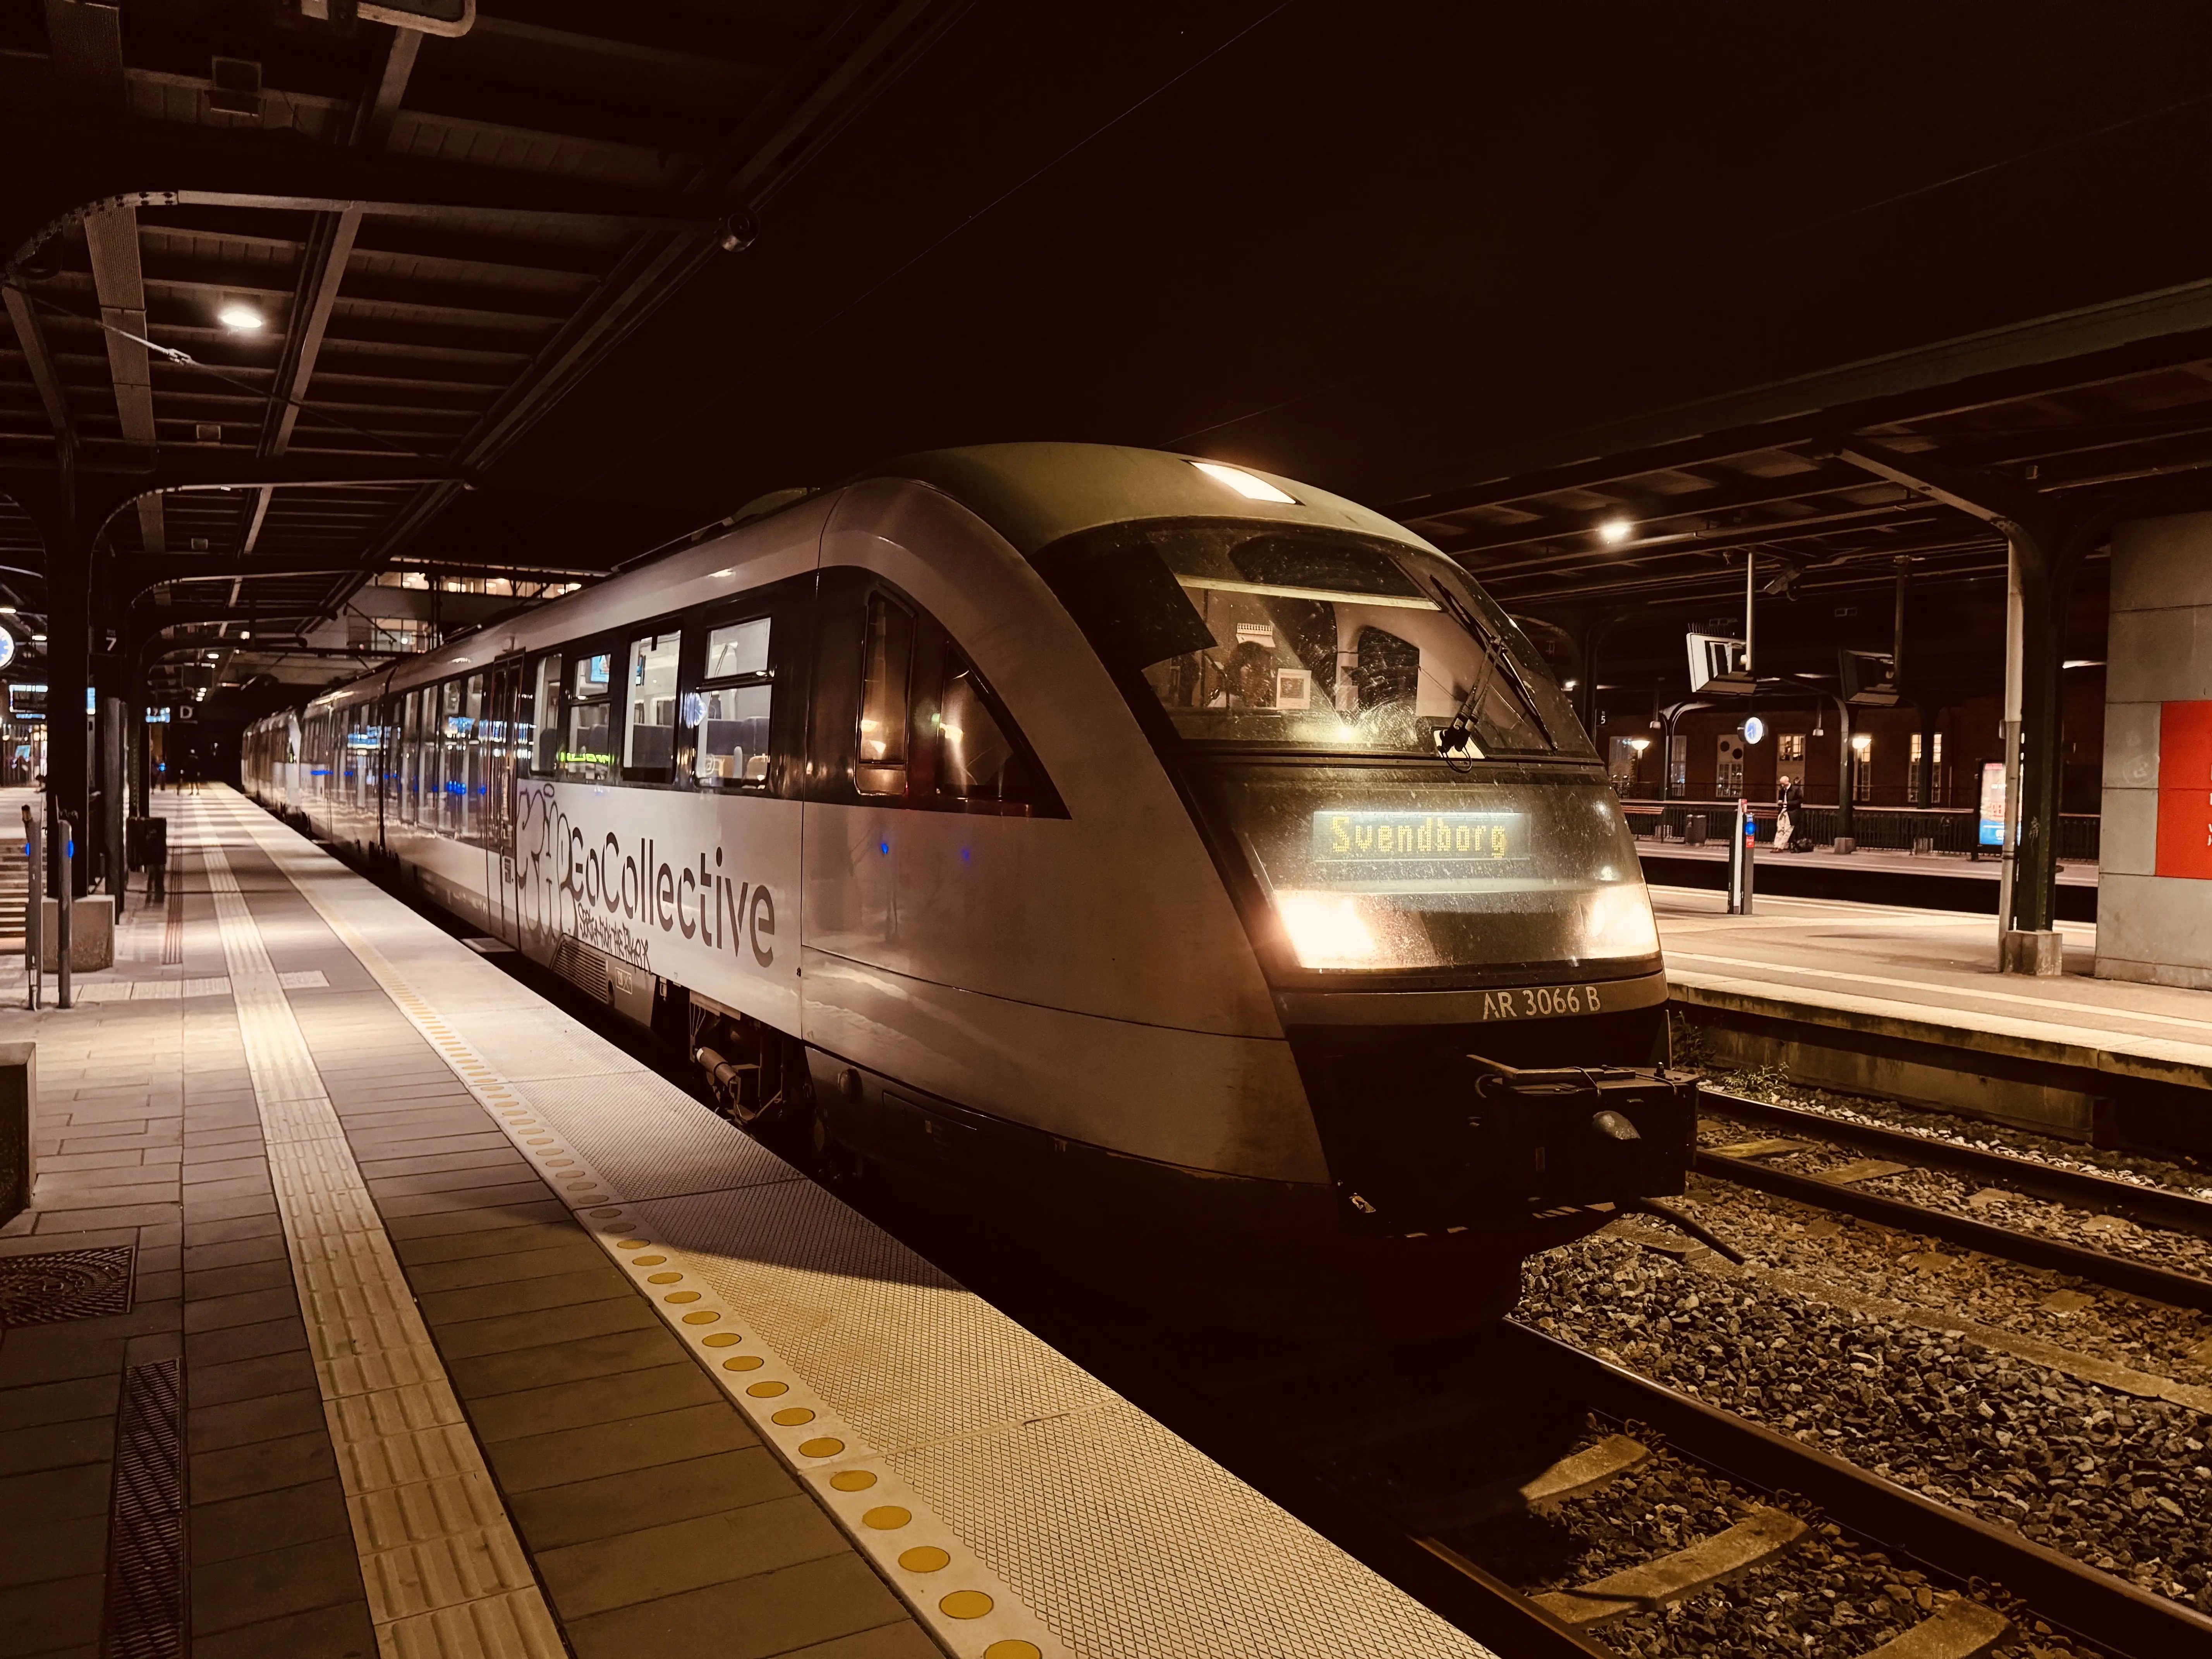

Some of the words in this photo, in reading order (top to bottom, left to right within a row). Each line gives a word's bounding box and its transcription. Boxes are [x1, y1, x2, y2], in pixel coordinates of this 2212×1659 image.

[106, 637, 117, 651] 7
[180, 705, 193, 719] D
[1601, 715, 1606, 724] 5
[1332, 816, 1506, 859] Svendborg
[571, 827, 775, 968] GoCollective
[1483, 992, 1517, 1020] AR
[1522, 988, 1580, 1016] 3066
[1586, 986, 1601, 1012] B
